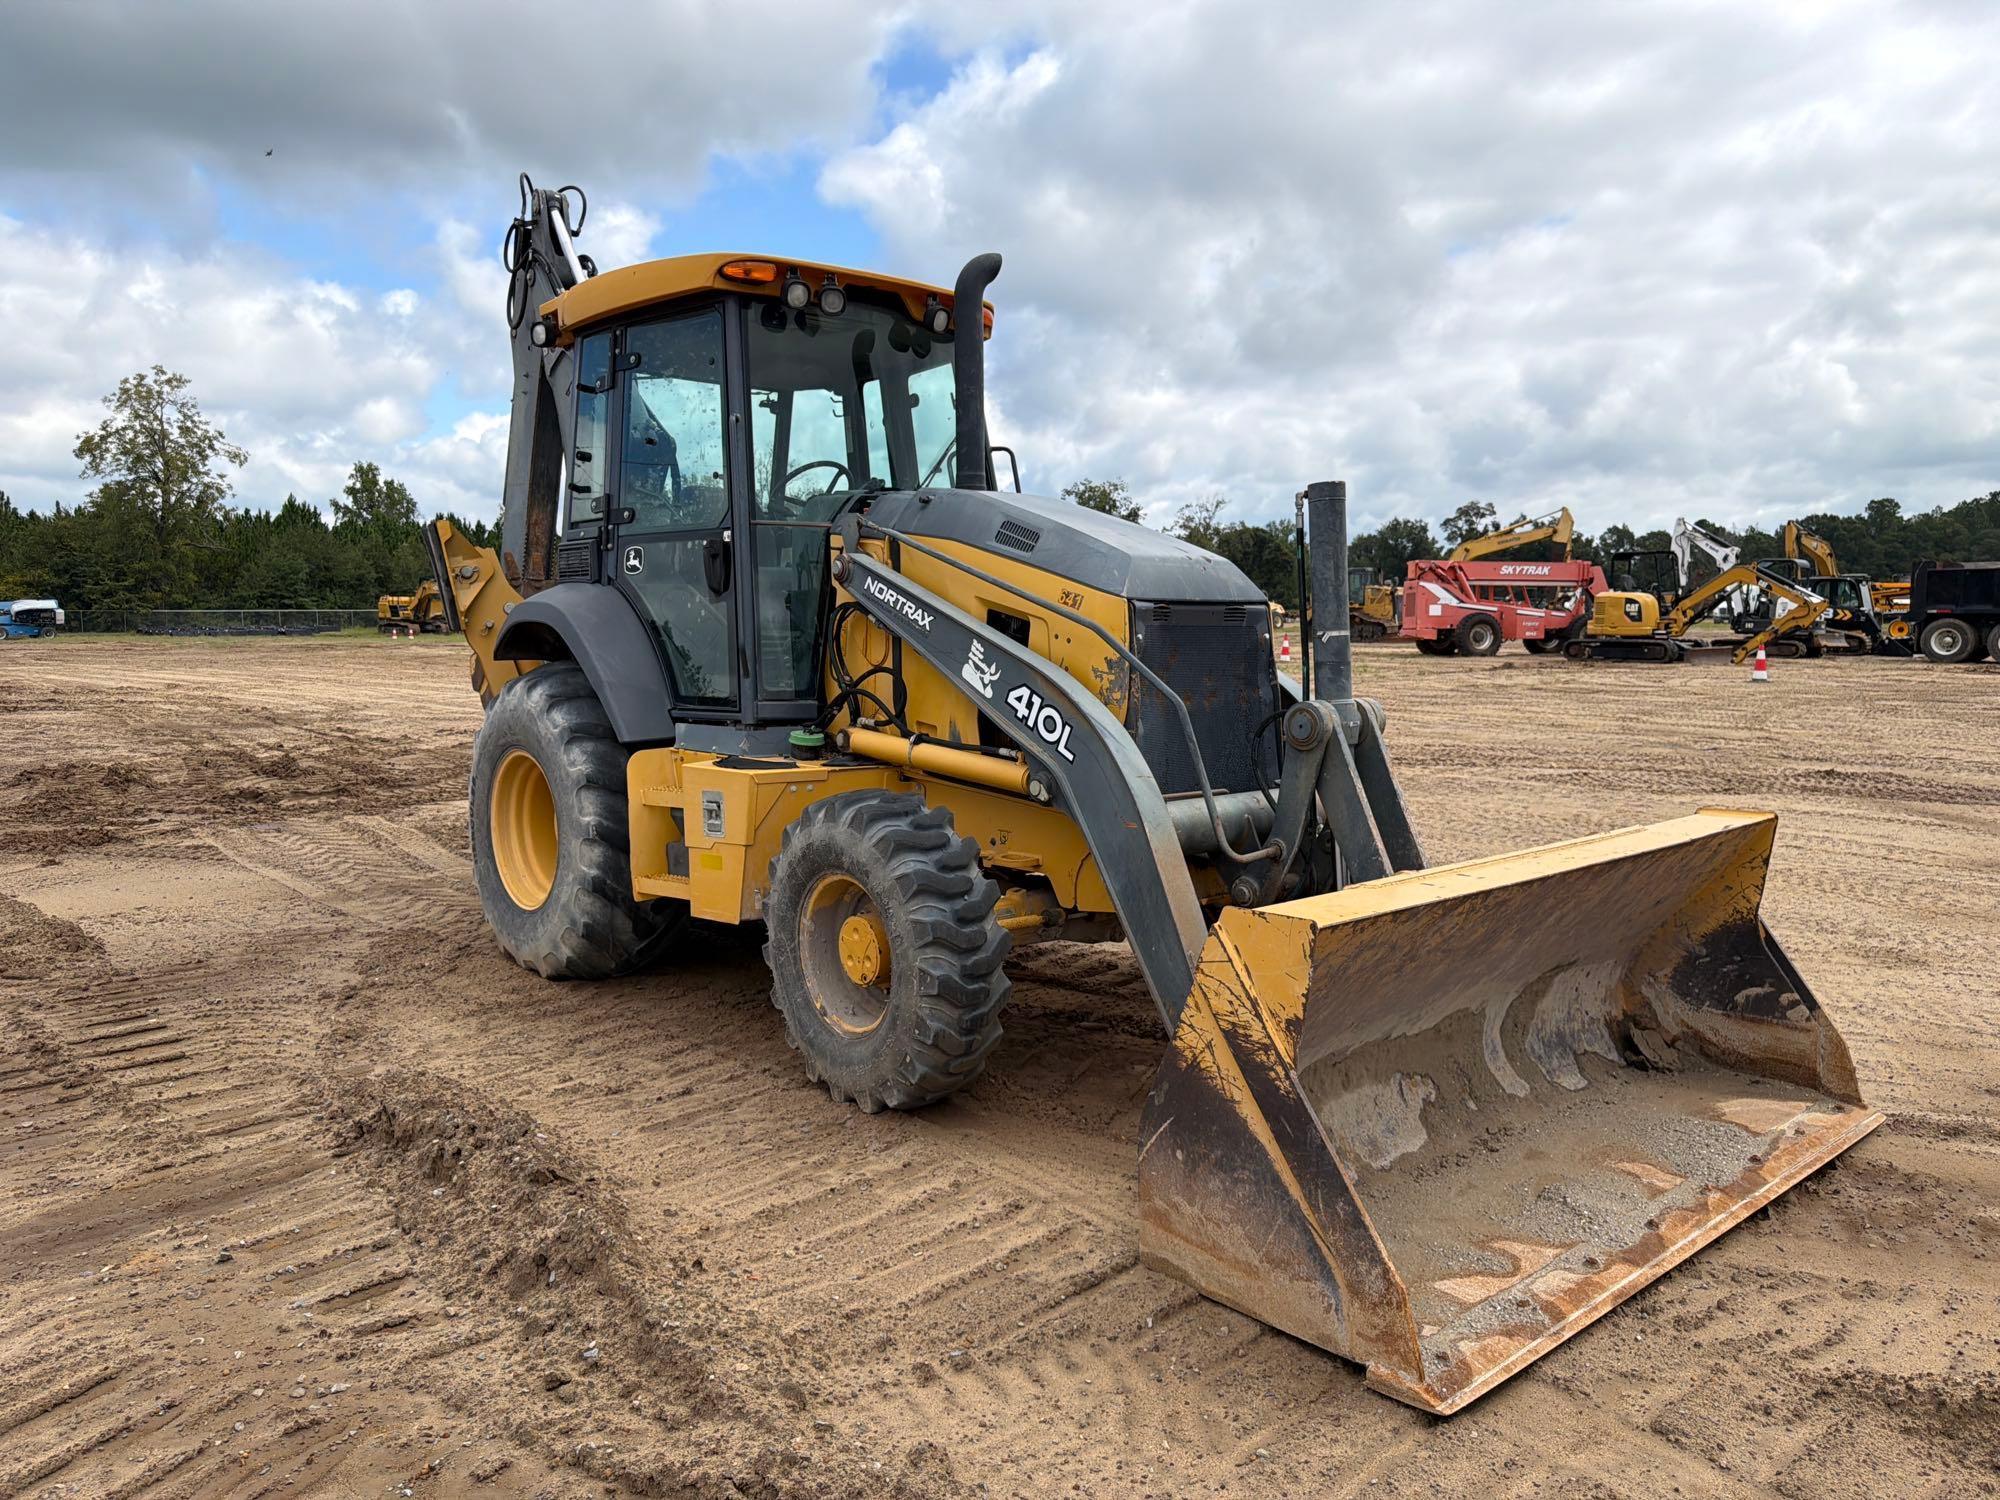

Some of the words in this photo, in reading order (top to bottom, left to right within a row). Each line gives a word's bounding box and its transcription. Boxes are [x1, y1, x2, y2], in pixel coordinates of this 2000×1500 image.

[1500, 565, 1550, 575] SKYTRAK
[863, 575, 935, 632] NORTRAX
[1058, 588, 1084, 611] 641
[1626, 603, 1639, 612] CAT
[1006, 685, 1075, 763] 410L
